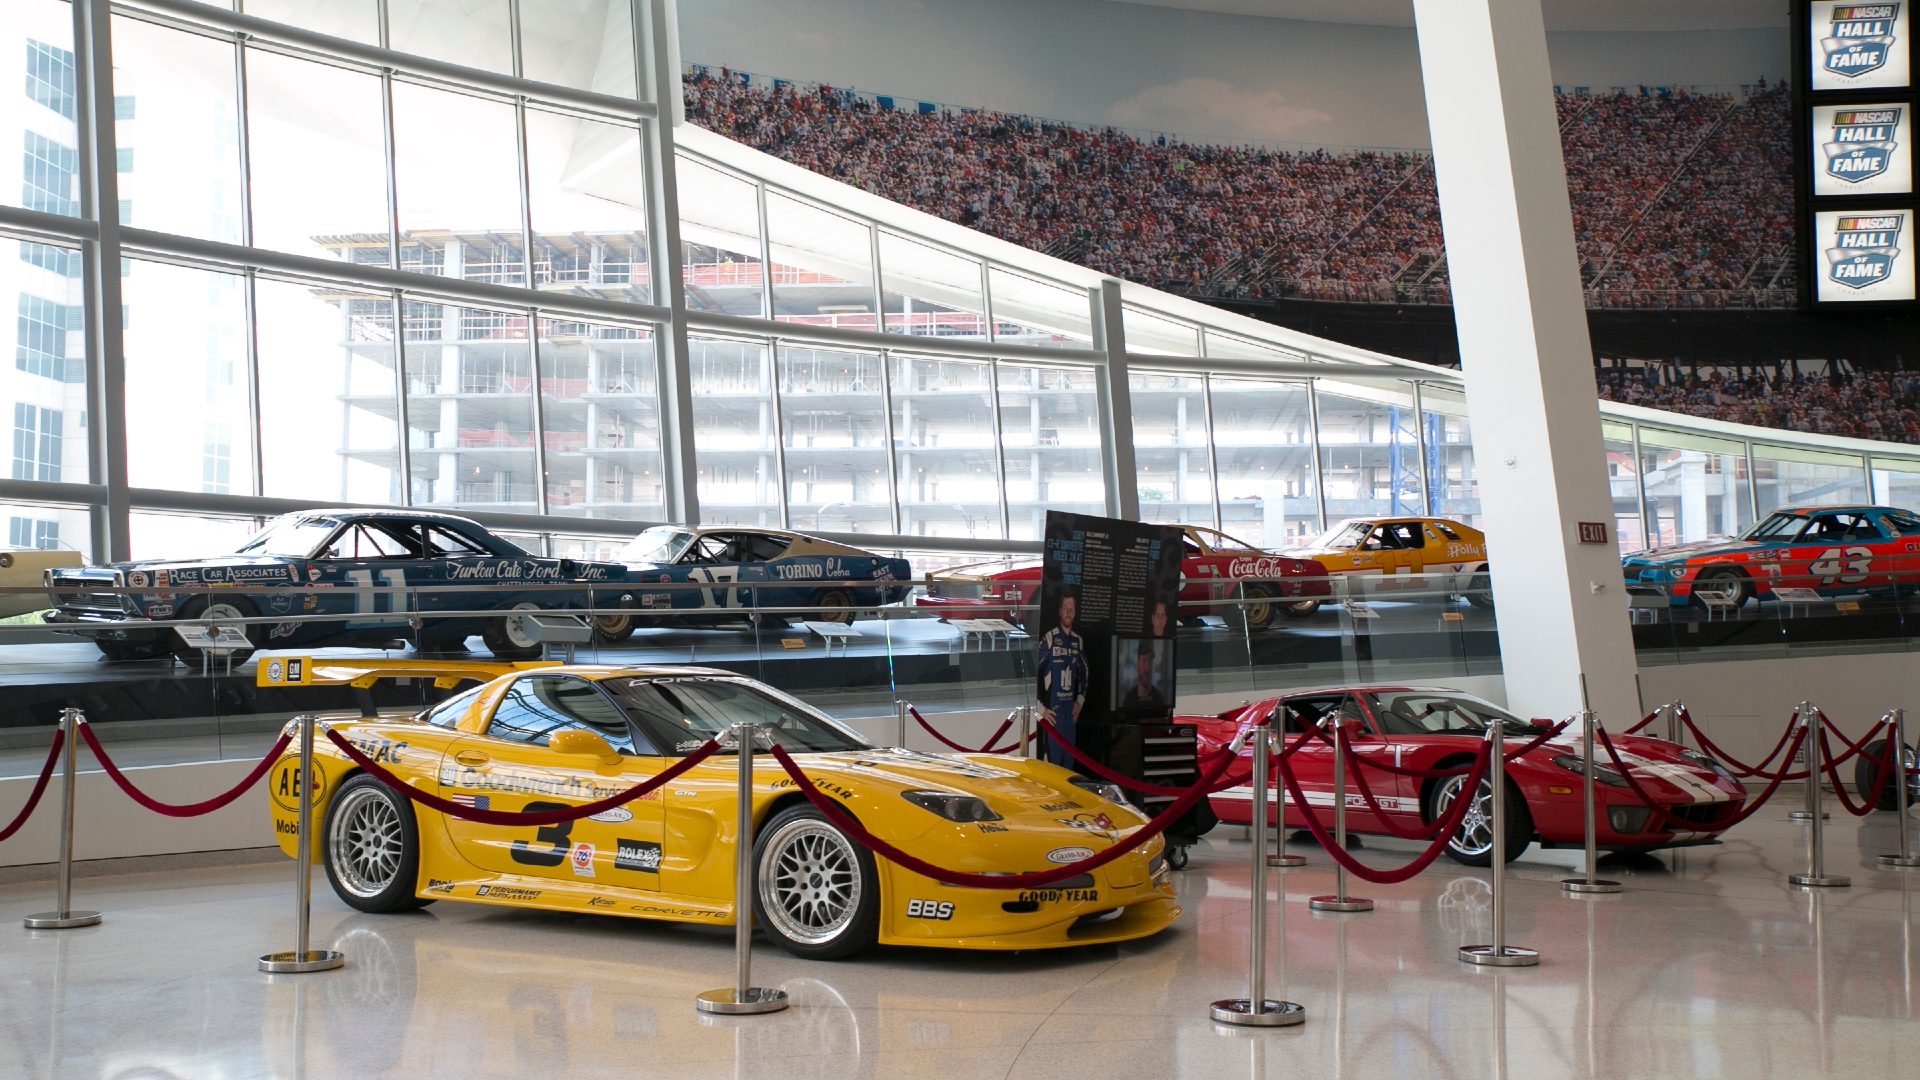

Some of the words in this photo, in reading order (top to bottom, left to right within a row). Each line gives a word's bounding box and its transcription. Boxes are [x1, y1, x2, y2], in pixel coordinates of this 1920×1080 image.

[1852, 6, 1892, 18] NASCAR
[1837, 22, 1884, 37] HALL
[1830, 51, 1879, 68] FAME
[1831, 76, 1872, 85] CHARLOTTE
[1854, 111, 1894, 123] NASCAR
[1839, 127, 1886, 142] HALL
[1832, 157, 1881, 172] FAME
[1834, 181, 1875, 190] CHARLOTTE
[1856, 217, 1897, 229] NASCAR
[1842, 233, 1889, 247] HALL
[1835, 263, 1884, 278] FAME
[1837, 287, 1878, 296] CHARLOTTE
[1582, 524, 1604, 542] EXIT
[1060, 540, 1084, 551] CORVETTE
[1447, 542, 1479, 558] Holly
[1052, 550, 1068, 561] ROLEX
[446, 561, 496, 579] Furlow
[496, 561, 522, 579] Cate
[577, 562, 608, 579] Inc.
[776, 564, 822, 579] TORINO
[826, 557, 851, 577] Cobra
[872, 565, 890, 578] EAST
[1061, 562, 1082, 573] DAYTONA
[1375, 550, 1430, 591] 11
[1807, 546, 1873, 587] 43
[169, 569, 198, 584] RACE
[202, 567, 224, 581] CAR
[226, 566, 288, 581] ASSOCIATES
[1062, 573, 1081, 585] TRIBUTE
[687, 565, 744, 608] 17
[345, 568, 408, 630] 11
[149, 606, 172, 614] WYNN'S
[289, 662, 300, 675] GM
[443, 768, 456, 780] GM
[279, 768, 316, 798] AE
[461, 767, 581, 801] Goodwrench
[584, 783, 630, 799] Servic
[1344, 796, 1378, 806] FOR
[1379, 799, 1397, 808] GT
[276, 819, 300, 835] Mobi
[978, 823, 1009, 834] Hella
[510, 801, 574, 867] 3
[576, 850, 589, 862] 76
[618, 846, 650, 861] ROLEX
[1055, 851, 1085, 860] GRAND-AM
[646, 857, 659, 868] 24
[491, 886, 542, 896] PERFORMANCE
[631, 905, 729, 918] CORVETTE
[907, 899, 955, 920] BBS
